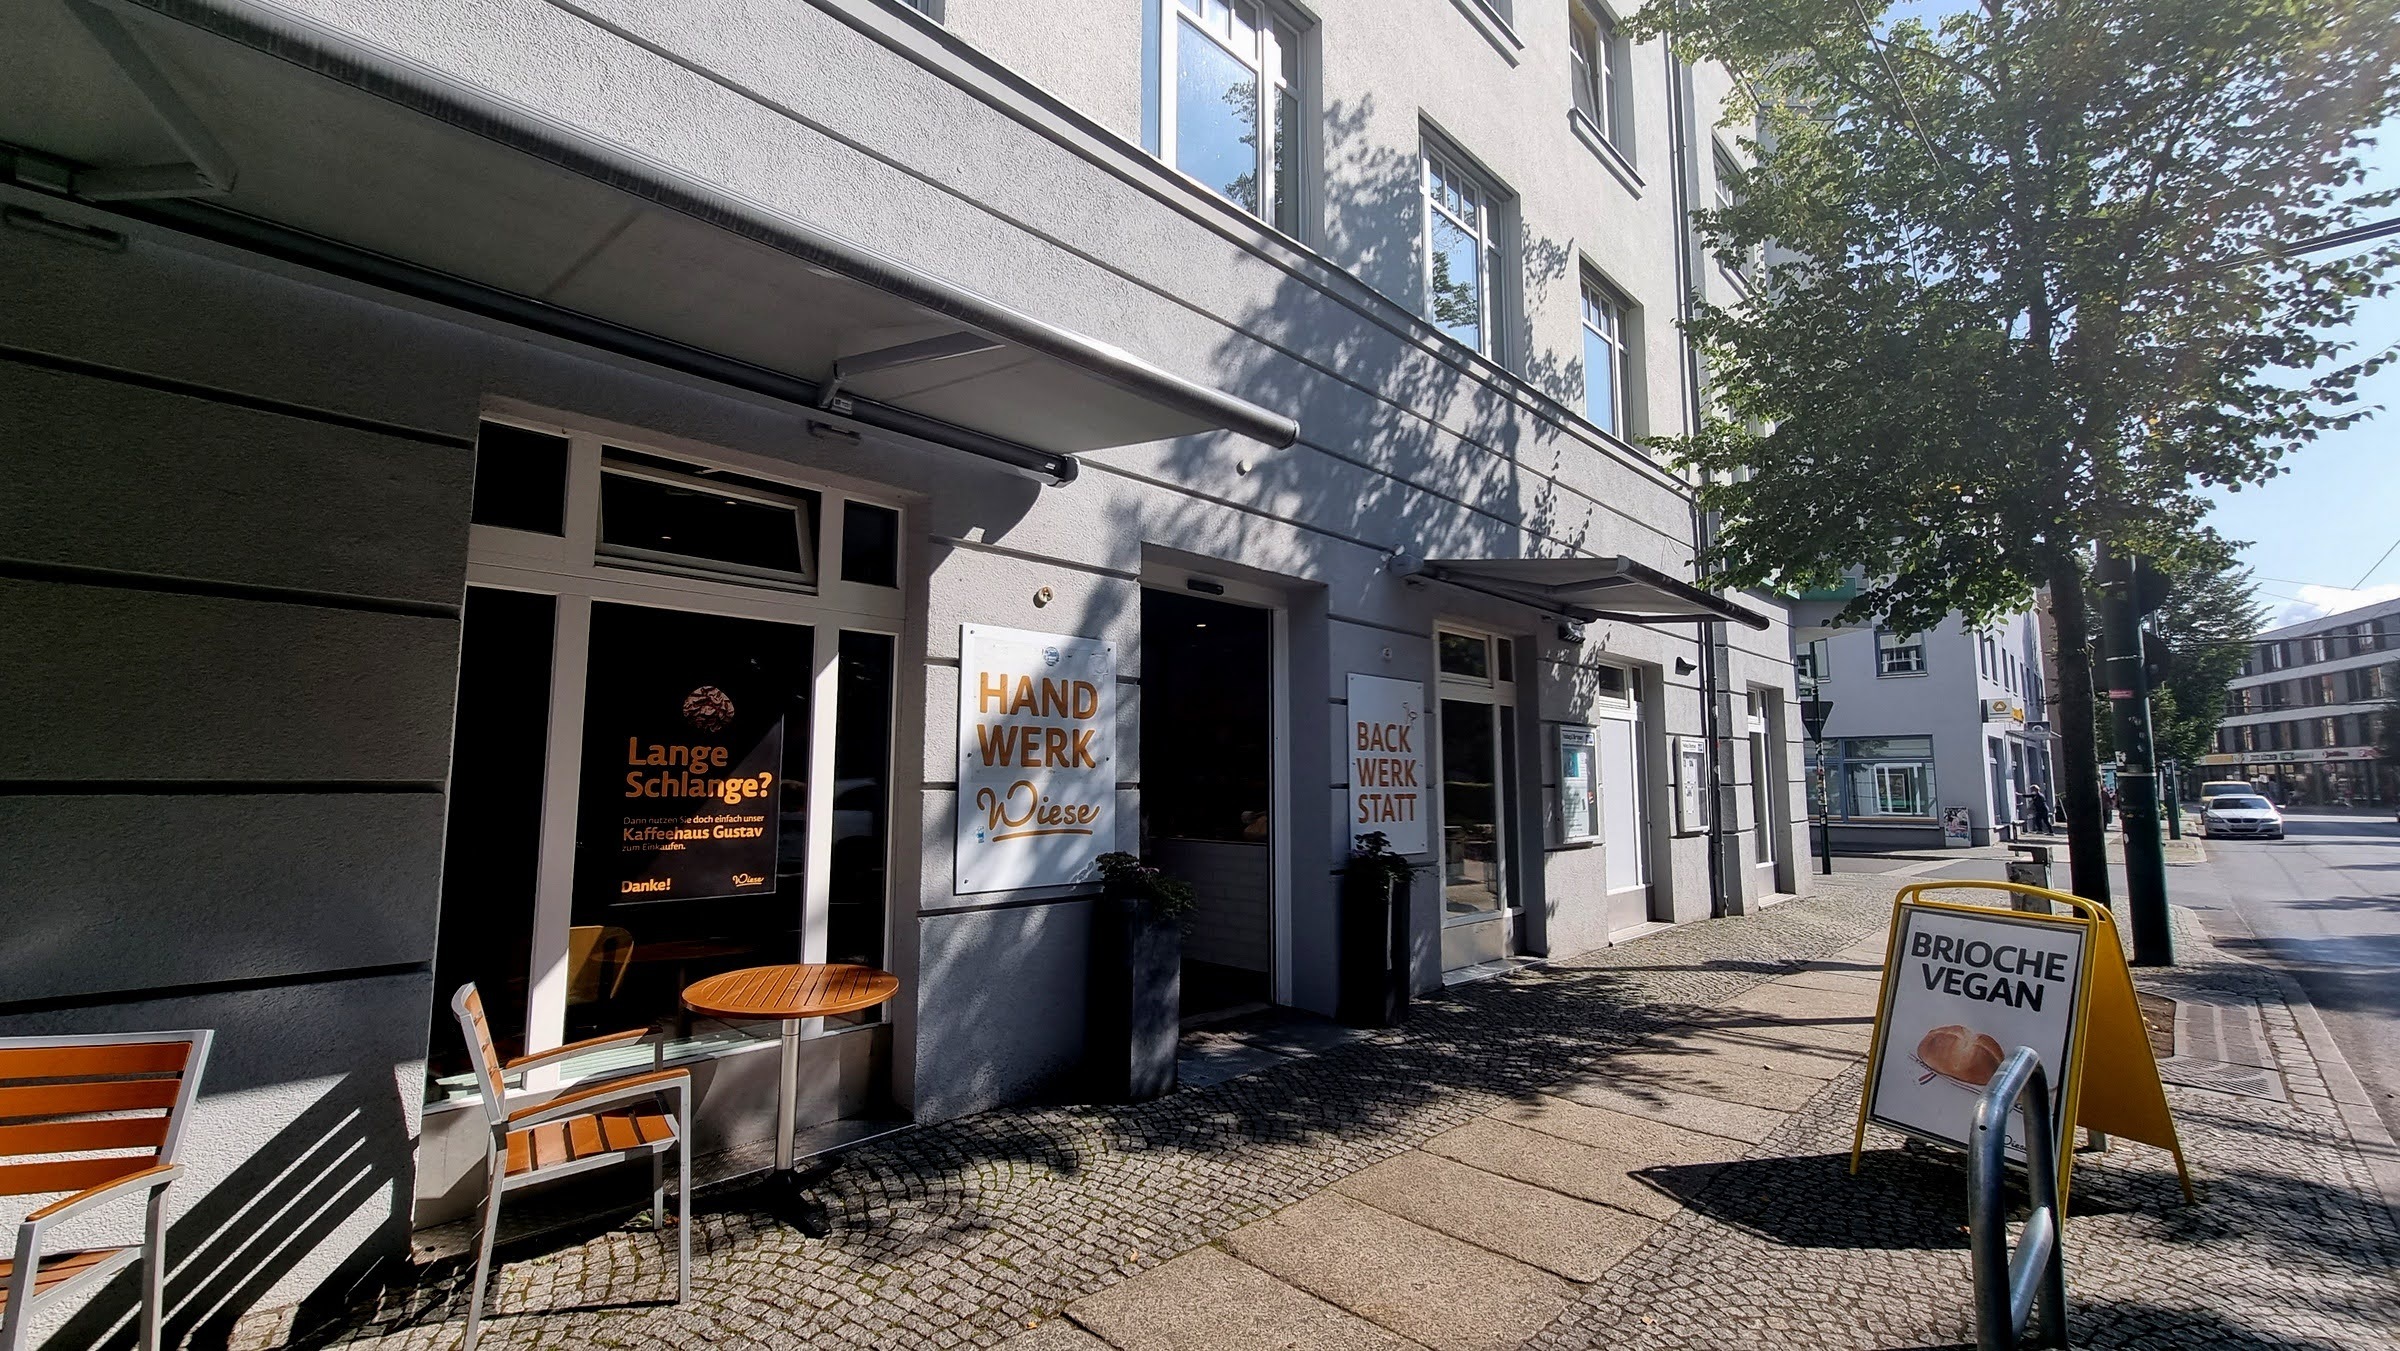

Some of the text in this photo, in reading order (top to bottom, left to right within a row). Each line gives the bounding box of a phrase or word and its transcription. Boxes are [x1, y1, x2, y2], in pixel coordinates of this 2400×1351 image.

[980, 672, 1098, 719] HAND
[976, 724, 1096, 769] WERK
[1357, 722, 1411, 752] BACK
[628, 736, 729, 774] Lange
[625, 771, 773, 805] Schlange?
[1357, 758, 1417, 787] WERK
[623, 814, 765, 825] Dann nutzen Sie doch einfach unser
[976, 780, 1100, 831] Wiese
[1358, 793, 1417, 824] STATT
[622, 842, 686, 852] zum Einkaufen.
[623, 825, 764, 841] Kaffeehaus Gustav
[621, 878, 672, 894] Danke!
[1911, 931, 2069, 983] BRIOCHE
[1921, 963, 2045, 1012] VEGAN
